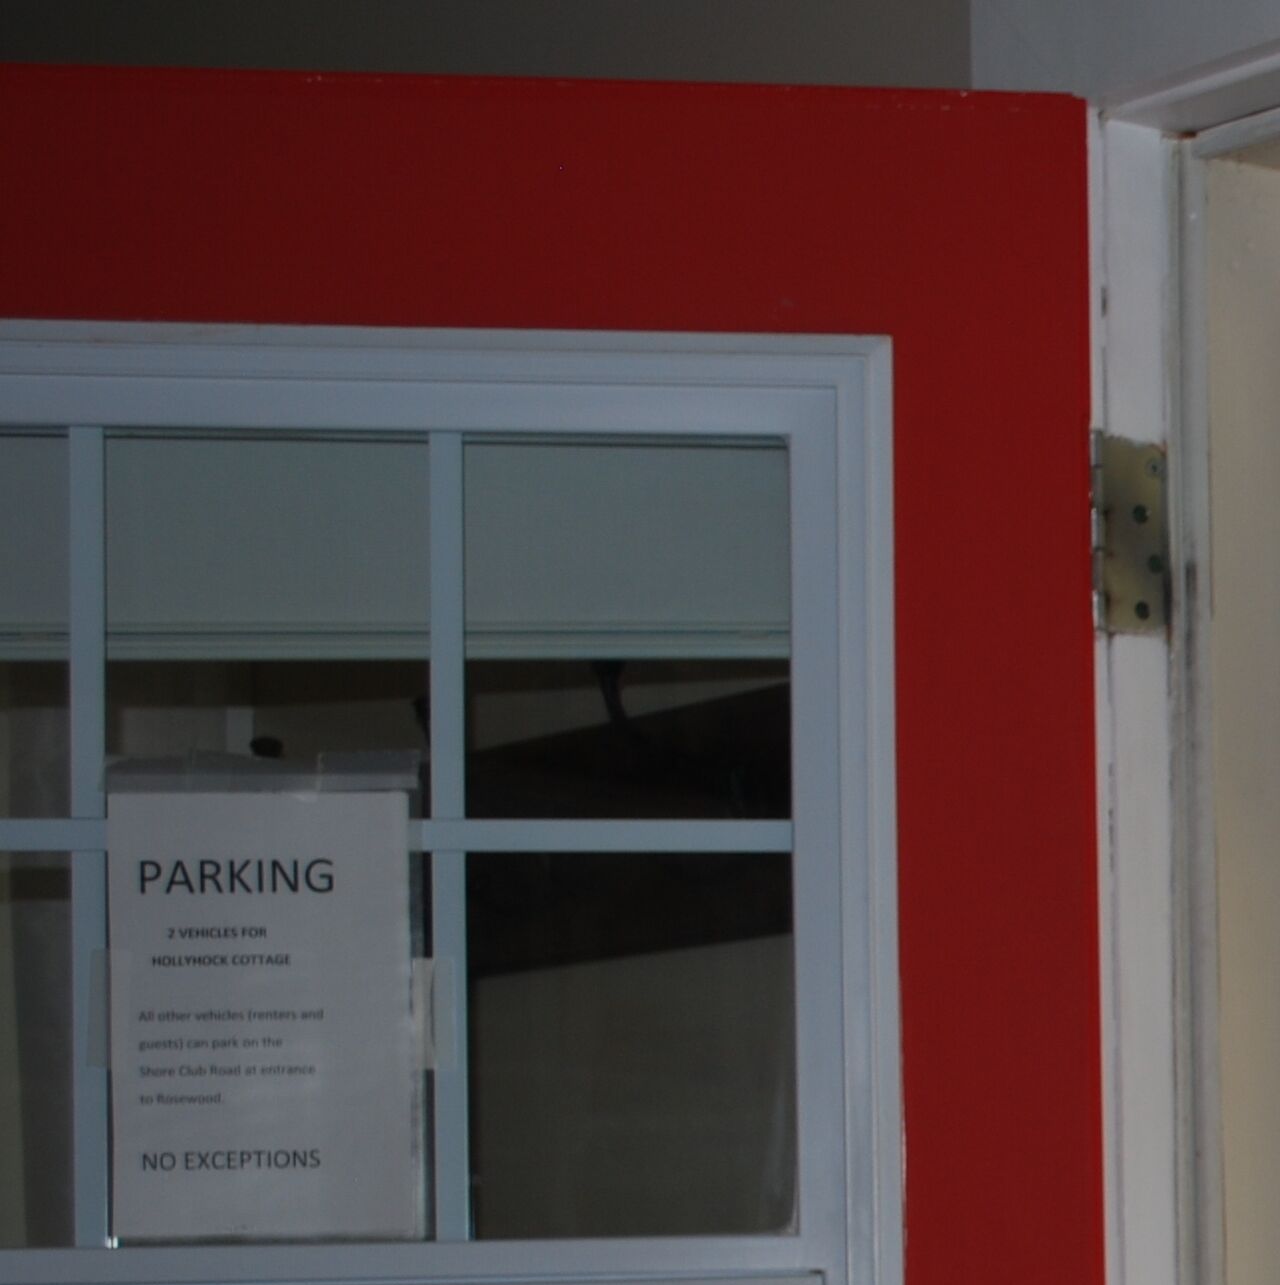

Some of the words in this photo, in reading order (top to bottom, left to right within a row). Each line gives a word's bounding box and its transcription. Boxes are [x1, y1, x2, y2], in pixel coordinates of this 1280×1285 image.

[138, 858, 335, 895] PARKING
[166, 926, 176, 940] 2
[178, 926, 238, 940] VEHICLES
[241, 925, 268, 939] FOR
[151, 954, 228, 968] HOLLYHOCK
[231, 953, 291, 966] COTTAGE
[138, 1009, 155, 1022] All
[157, 1009, 191, 1022] other
[194, 1009, 244, 1022] vehicles
[247, 1009, 297, 1022] (renters
[300, 1008, 324, 1021] and
[138, 1038, 184, 1052] guests)
[186, 1040, 209, 1049] can
[211, 1037, 239, 1051] park
[242, 1039, 259, 1049] on
[261, 1037, 283, 1048] the
[139, 1065, 176, 1077] Shore
[178, 1064, 207, 1076] Club
[209, 1064, 241, 1076] Road
[244, 1065, 257, 1076] at
[260, 1065, 316, 1076] entrance
[139, 1093, 154, 1105] to
[142, 1151, 177, 1171] NO
[184, 1148, 322, 1170] EXCEPTIONS
